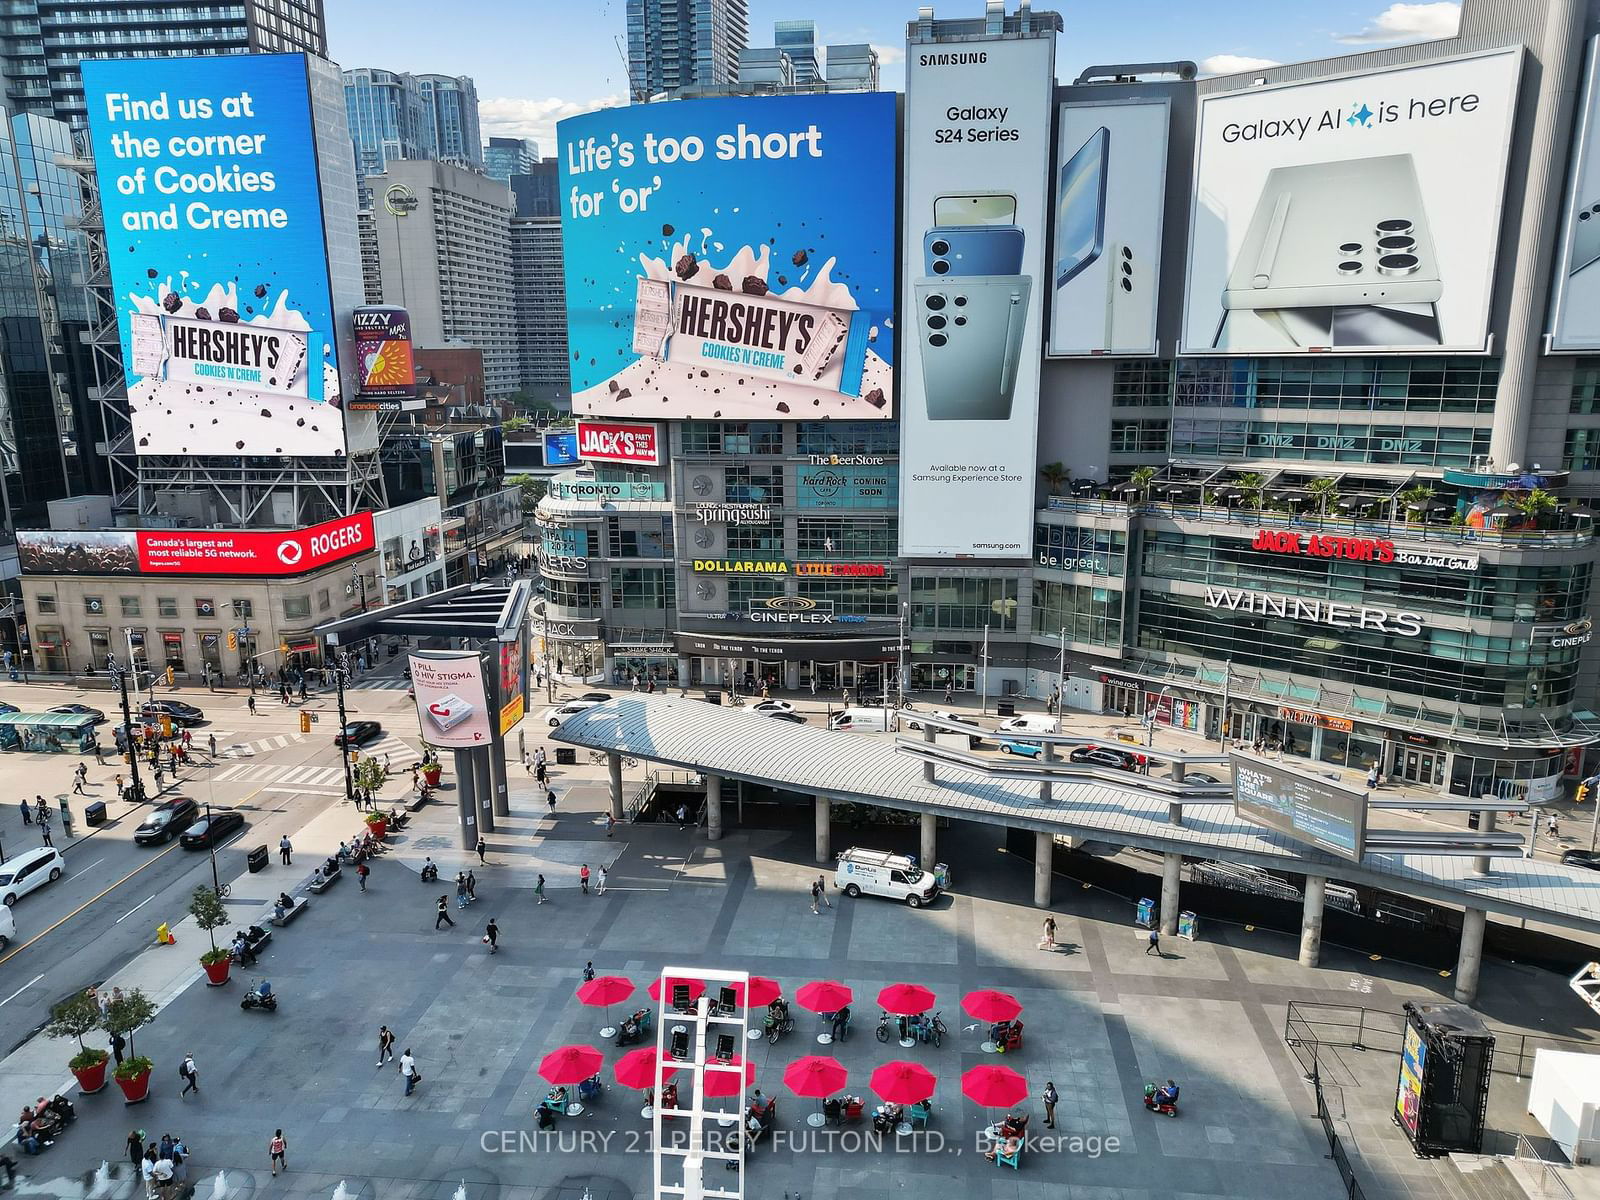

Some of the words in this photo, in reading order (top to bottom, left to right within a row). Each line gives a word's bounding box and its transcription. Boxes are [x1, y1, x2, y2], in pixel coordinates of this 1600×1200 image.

[920, 52, 987, 66] SAMSUNG
[106, 92, 170, 121] Find
[178, 98, 214, 119] us
[221, 92, 254, 118] at
[946, 106, 1008, 123] Galaxy
[1222, 116, 1312, 143] Galaxy
[1318, 108, 1341, 131] AI
[1378, 101, 1399, 123] is
[1408, 93, 1479, 120] here
[935, 129, 963, 144] S24
[967, 126, 1019, 142] Series
[110, 130, 160, 158] the
[168, 134, 266, 157] corner
[568, 133, 634, 176] Life's
[644, 133, 704, 164] too
[715, 124, 822, 160] short
[116, 167, 146, 195] of
[154, 164, 276, 194] Cookies
[570, 186, 604, 219] for
[612, 176, 662, 214] 'or'
[122, 203, 178, 231] and
[186, 202, 288, 230] Creme
[390, 323, 406, 336] MAX
[680, 294, 814, 355] HERSHEY'S
[173, 326, 280, 370] HERSHEY'S
[702, 342, 740, 362] COOKIES
[752, 350, 785, 370] CREME
[194, 362, 226, 378] COOKIES
[236, 368, 262, 382] CREME
[582, 430, 635, 455] JACK'S
[1258, 435, 1294, 446] DMZ
[1317, 436, 1356, 449] DMZ
[1381, 439, 1422, 451] DMZ
[636, 448, 648, 456] WAY
[808, 455, 829, 465] The
[912, 474, 950, 483] Samsung
[952, 474, 998, 482] Experience
[1000, 474, 1022, 482] Store
[565, 484, 620, 494] TORONTO
[146, 538, 184, 548] Canada's
[186, 539, 215, 549] largest
[216, 539, 233, 548] and
[311, 524, 362, 557] ROGERS
[1252, 530, 1302, 554] JACK
[1306, 535, 1394, 563] ASTOR'S
[172, 549, 202, 557] reliable
[204, 550, 218, 558] 5G
[219, 550, 257, 558] network.
[1040, 552, 1057, 566] be
[1064, 558, 1104, 570] great.
[1398, 552, 1422, 564] Bar
[1448, 558, 1478, 570] Grill
[694, 560, 788, 573] DOLLARAMA
[796, 564, 832, 576] LITTLE
[832, 564, 885, 576] CANADA
[750, 612, 832, 624] CINEPLEX
[1205, 586, 1422, 636] WINNERS
[422, 672, 435, 680] HIV
[437, 672, 476, 680] STIGMA.
[1108, 678, 1124, 686] wine
[1124, 681, 1139, 690] rack
[1239, 766, 1272, 783] WHAT'S
[1239, 774, 1251, 783] ON
[1254, 779, 1264, 787] AT
[1239, 780, 1256, 790] THE
[1240, 786, 1274, 802] SQUARE
